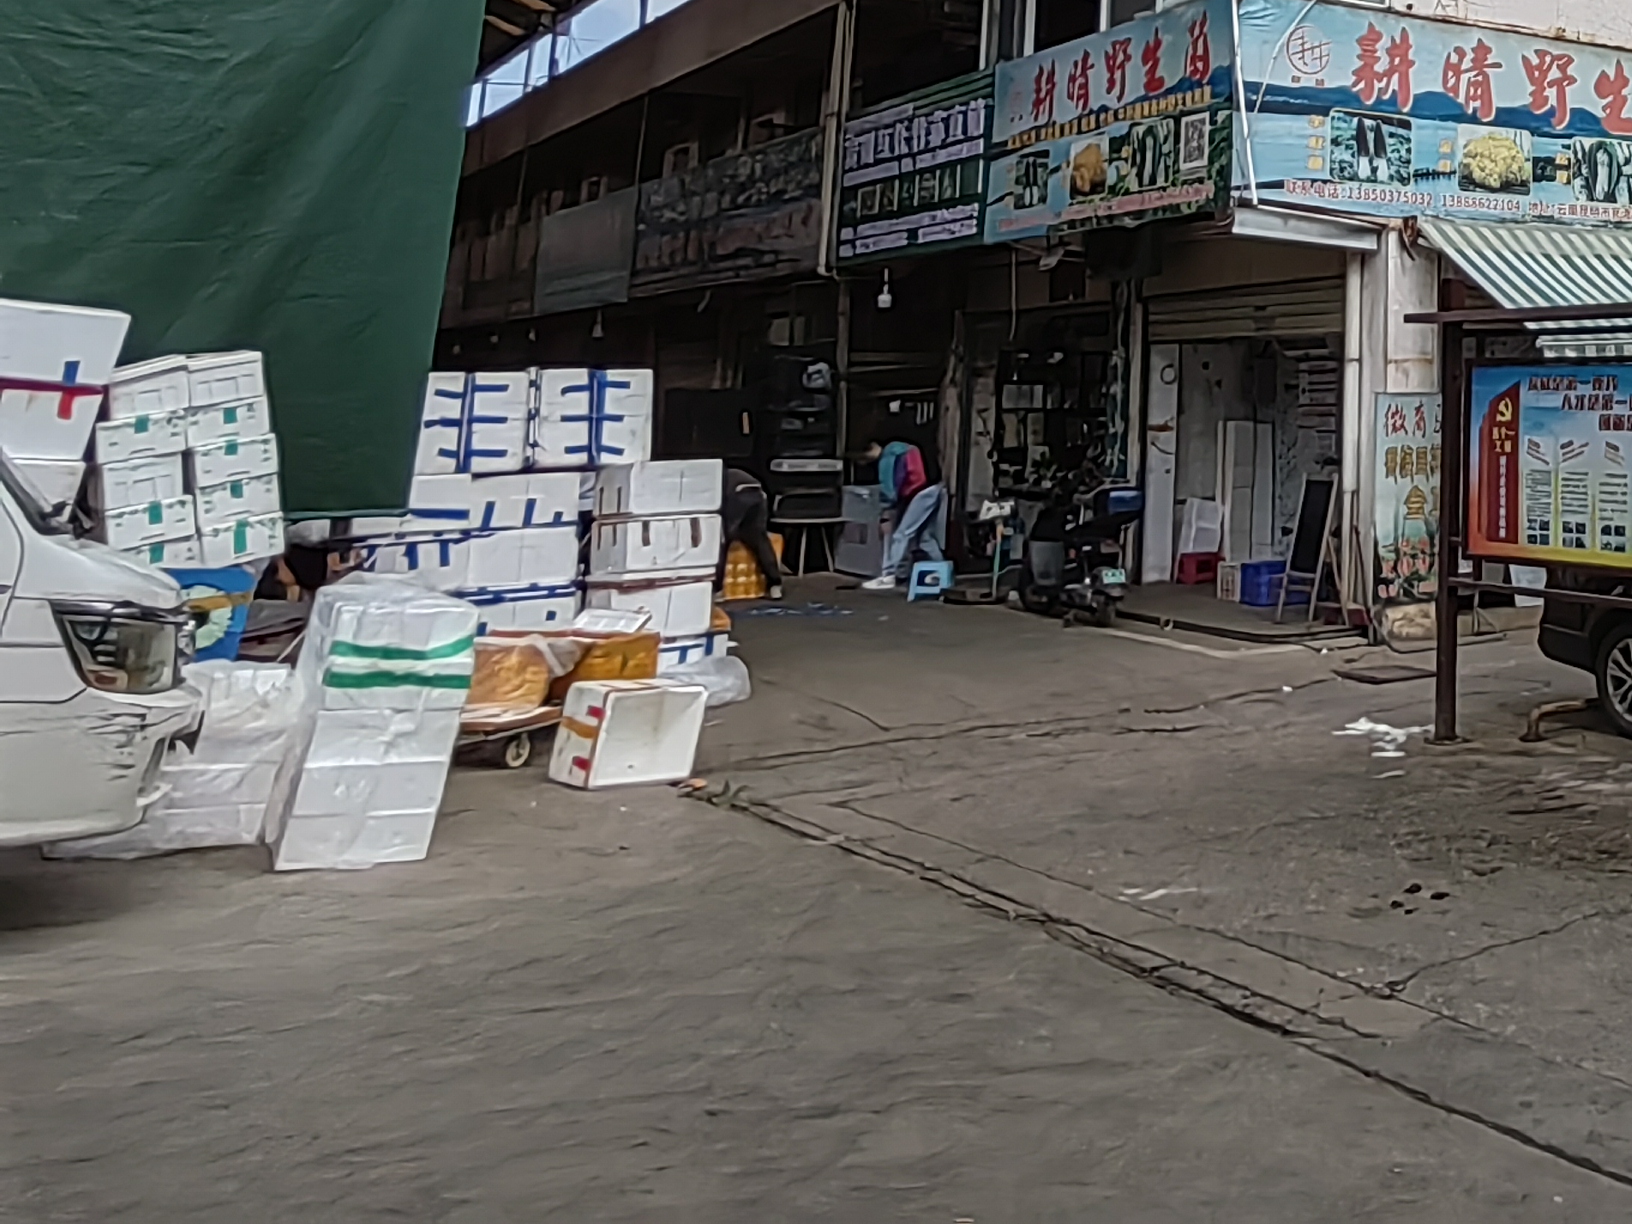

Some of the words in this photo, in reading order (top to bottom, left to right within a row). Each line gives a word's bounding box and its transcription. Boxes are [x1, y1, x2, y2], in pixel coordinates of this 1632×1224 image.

[1030, 12, 1211, 123] 耕晴野生菌
